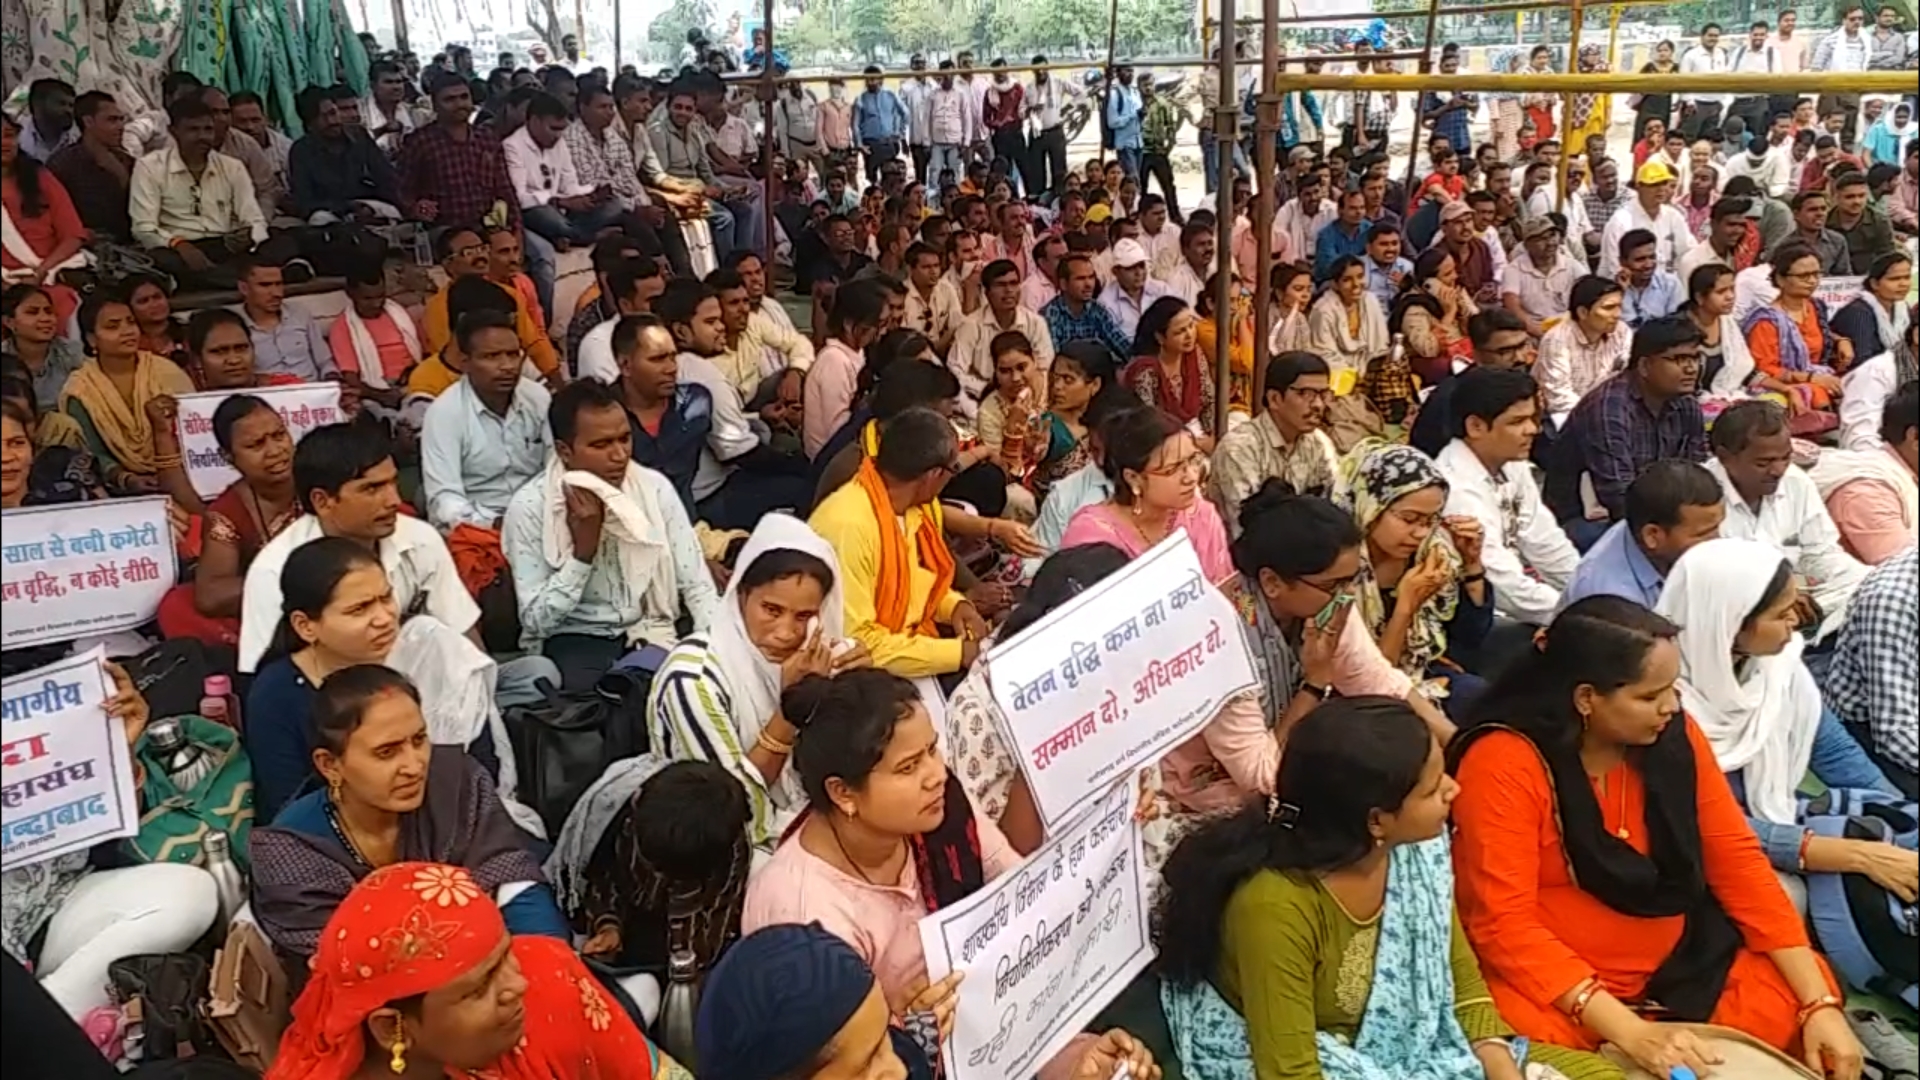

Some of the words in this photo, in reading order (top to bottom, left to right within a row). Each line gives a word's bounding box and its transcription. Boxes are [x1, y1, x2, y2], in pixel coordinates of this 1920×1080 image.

[2, 542, 45, 564] साल
[48, 533, 67, 557] से
[69, 528, 107, 555] बनी
[109, 521, 159, 550] कमेटी
[69, 572, 83, 590] न
[87, 561, 121, 589] कोई
[121, 555, 161, 583] नीति
[1008, 669, 1056, 712] वेतन
[1060, 641, 1102, 687] वृद्धि
[1102, 618, 1141, 653] कम
[1142, 602, 1168, 632] ना
[1167, 568, 1207, 611] करो
[1031, 713, 1098, 771] सम्मान
[1132, 646, 1203, 705] अधिकार
